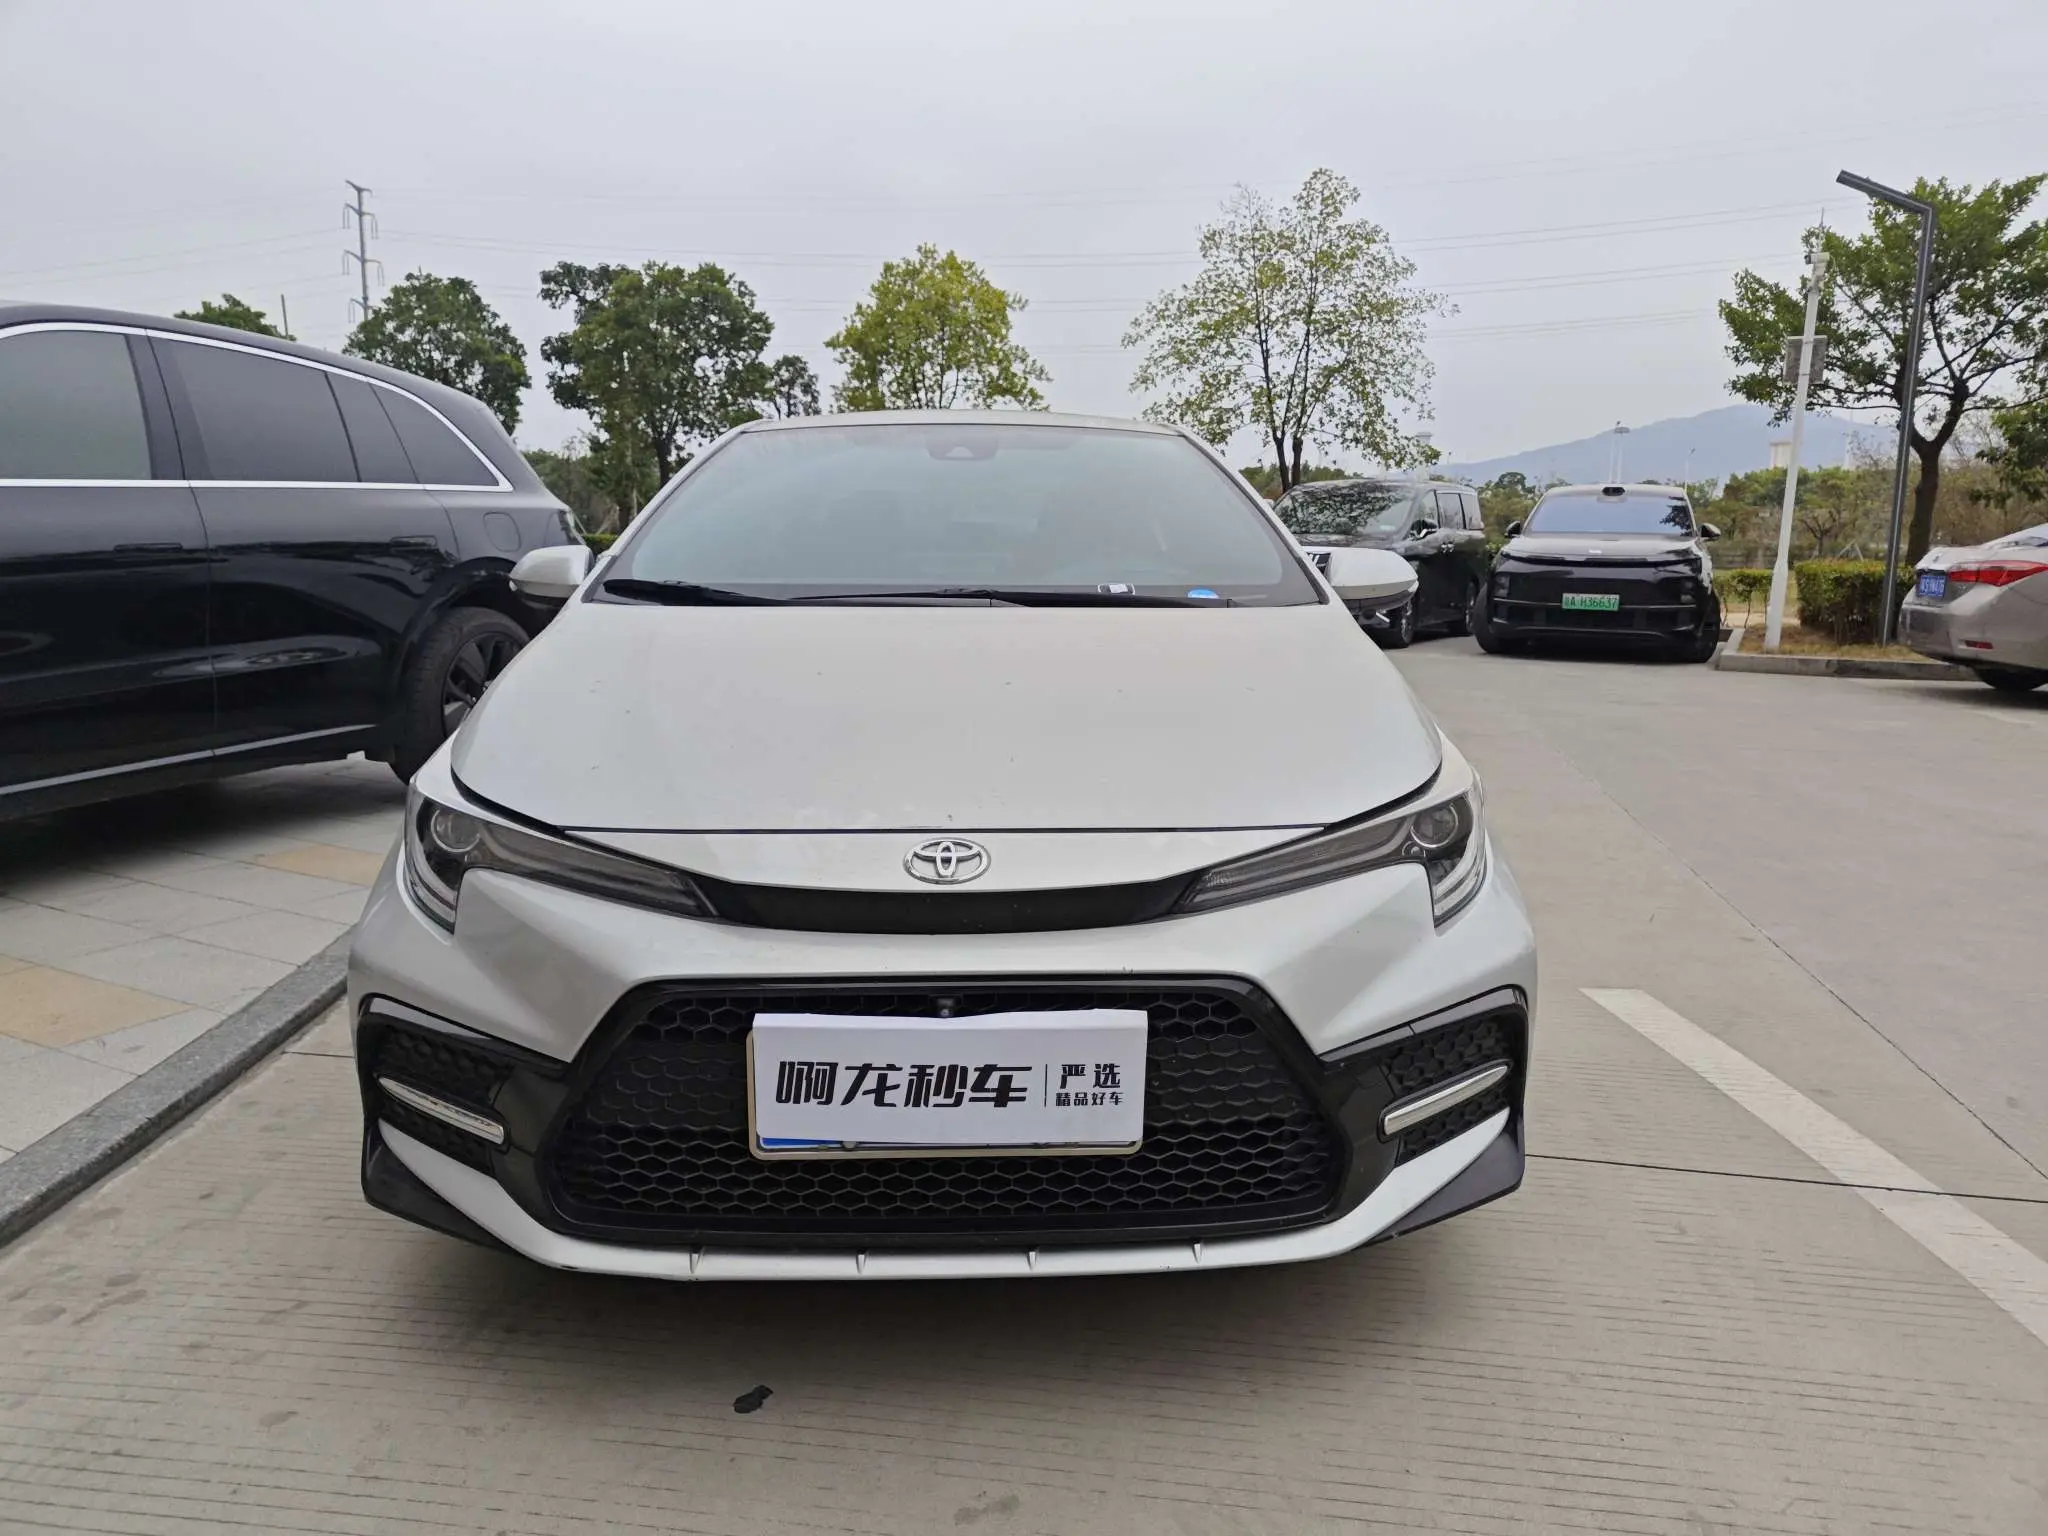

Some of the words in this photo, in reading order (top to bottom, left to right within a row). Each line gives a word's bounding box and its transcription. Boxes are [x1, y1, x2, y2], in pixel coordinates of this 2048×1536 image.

[775, 1060, 1033, 1108] 啊龙秒车
[1059, 1063, 1121, 1089] 严选
[1055, 1092, 1124, 1106] 精品好车
